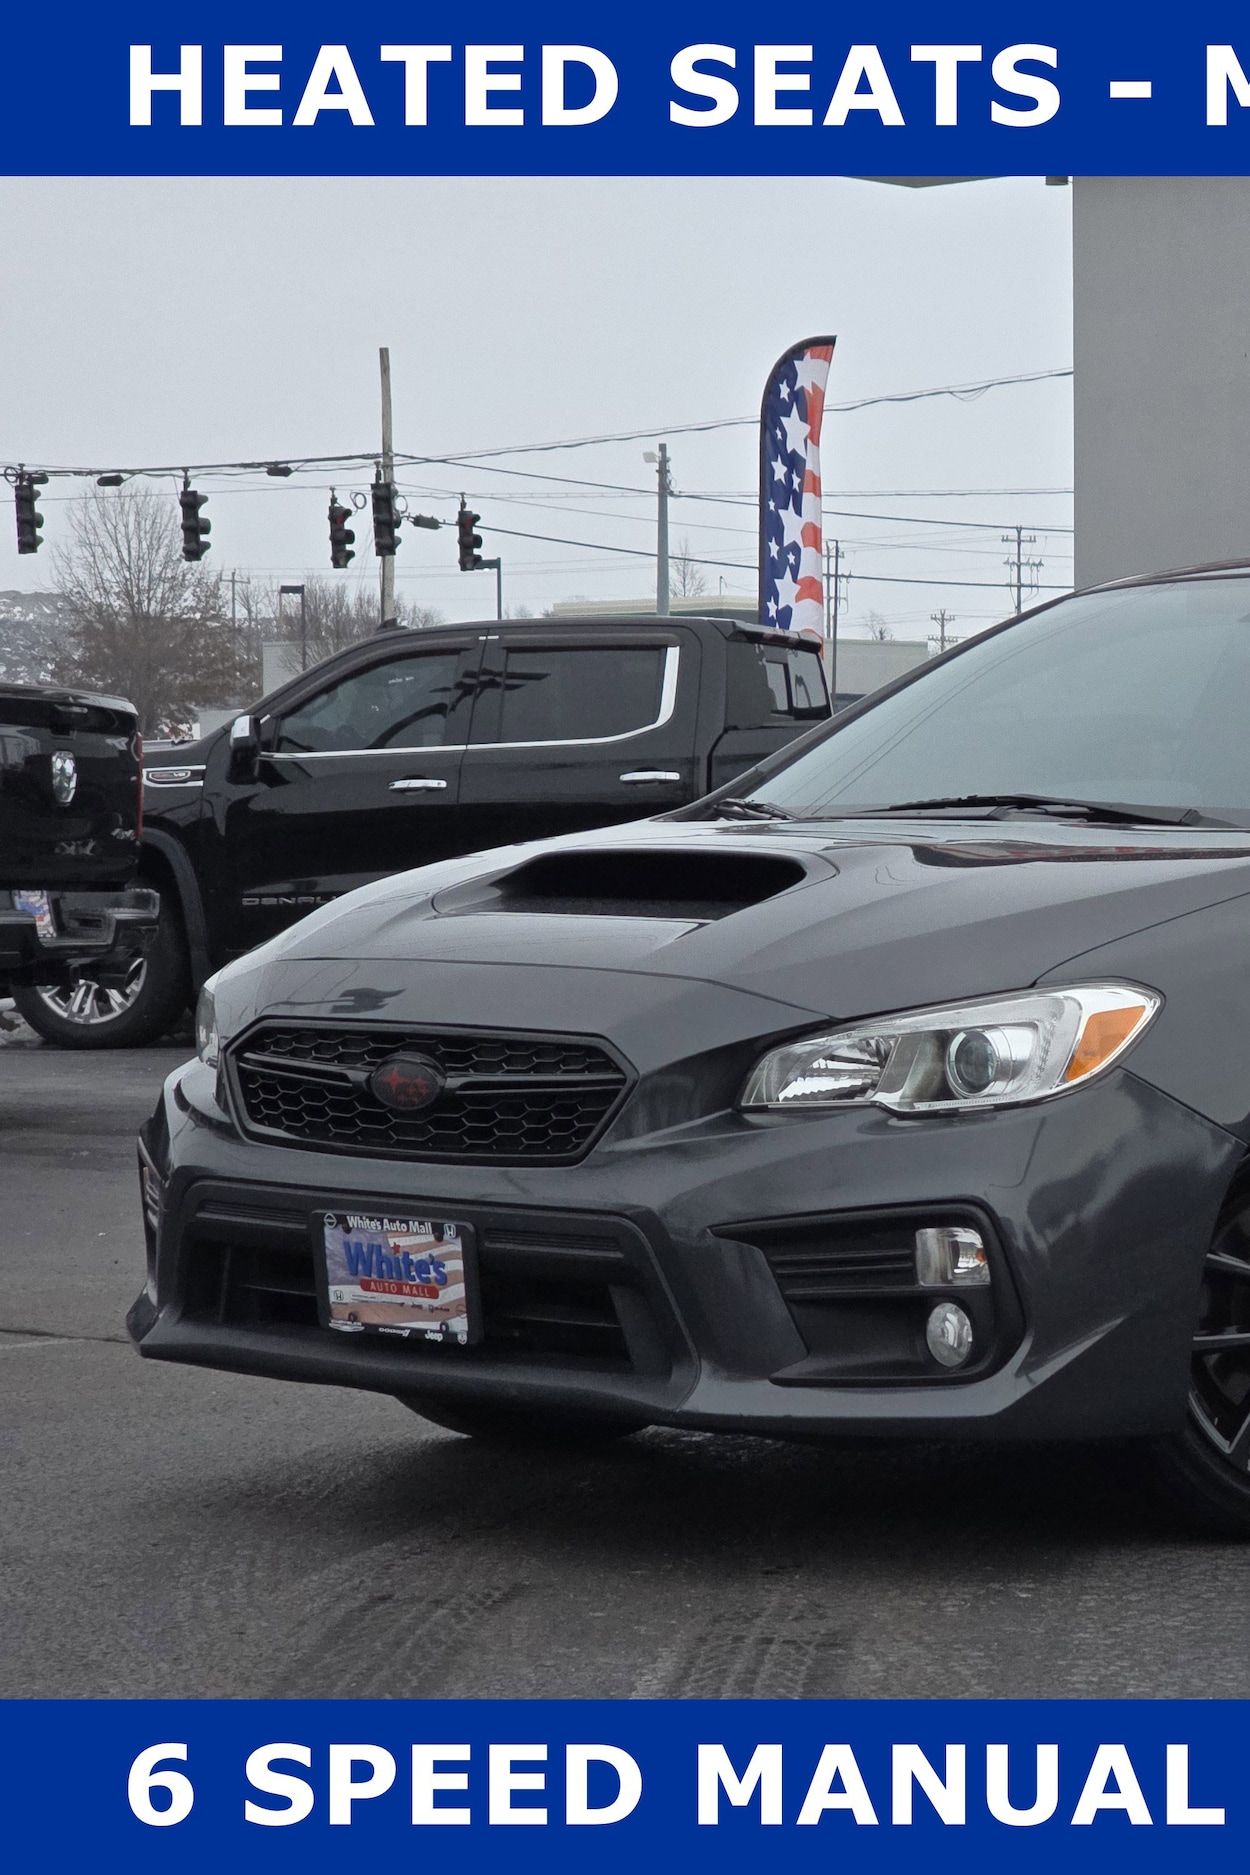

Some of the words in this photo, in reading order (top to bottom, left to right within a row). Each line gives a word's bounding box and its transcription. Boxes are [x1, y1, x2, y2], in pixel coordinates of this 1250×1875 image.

[347, 1215, 382, 1231] White's
[383, 1218, 408, 1232] Auto
[408, 1220, 433, 1235] Mall
[343, 1240, 449, 1286] White's
[370, 1281, 398, 1294] AUTO
[402, 1285, 430, 1298] MALL
[424, 1329, 444, 1342] Jeep
